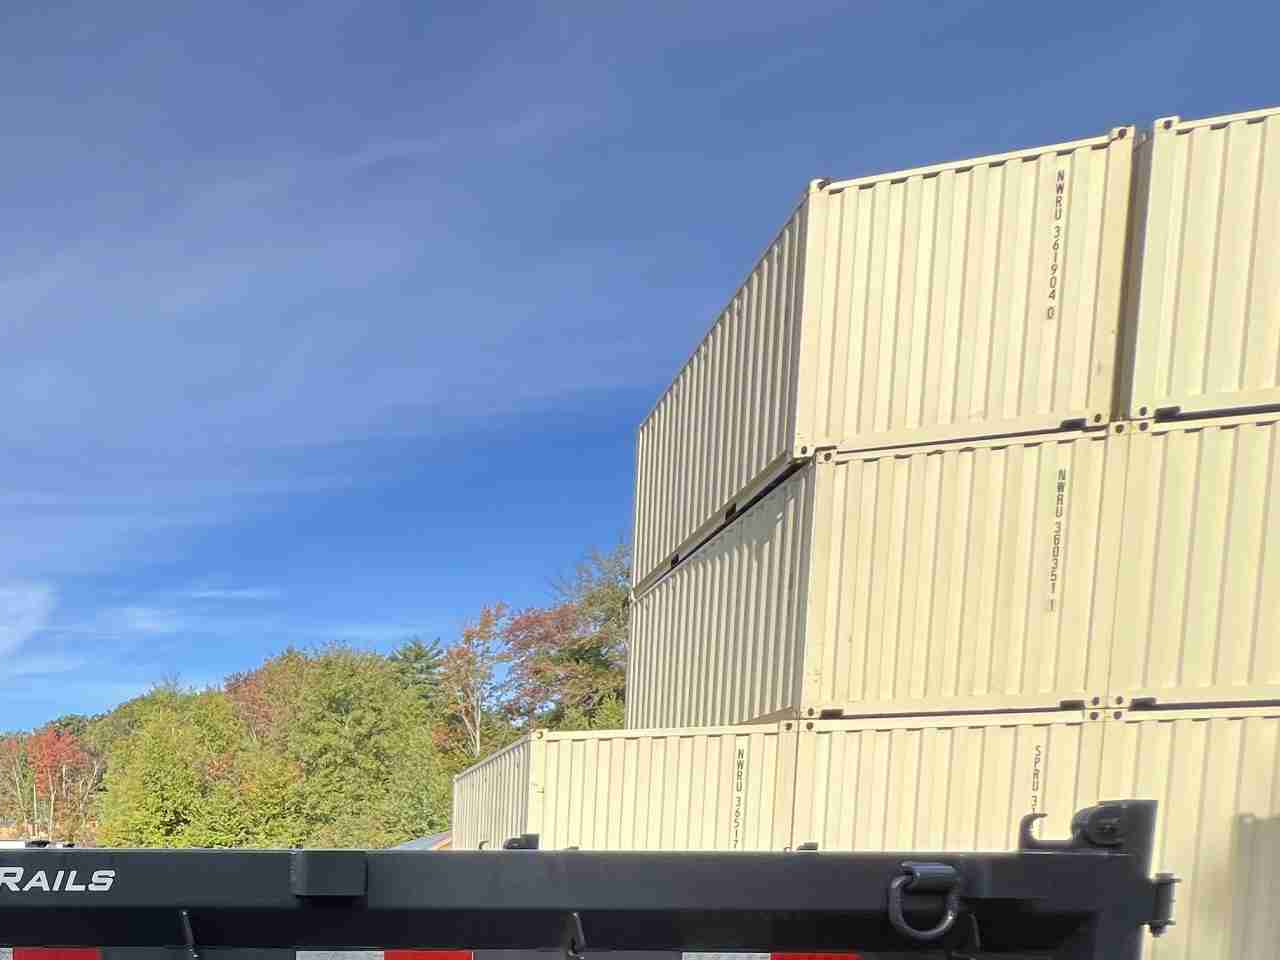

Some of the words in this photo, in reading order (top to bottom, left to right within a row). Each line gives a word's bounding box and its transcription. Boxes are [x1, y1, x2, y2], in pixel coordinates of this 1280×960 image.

[1054, 169, 1065, 221] NWRU
[1048, 225, 1061, 301] 361904
[1055, 469, 1066, 518] NWRU
[735, 748, 745, 793] NWRU
